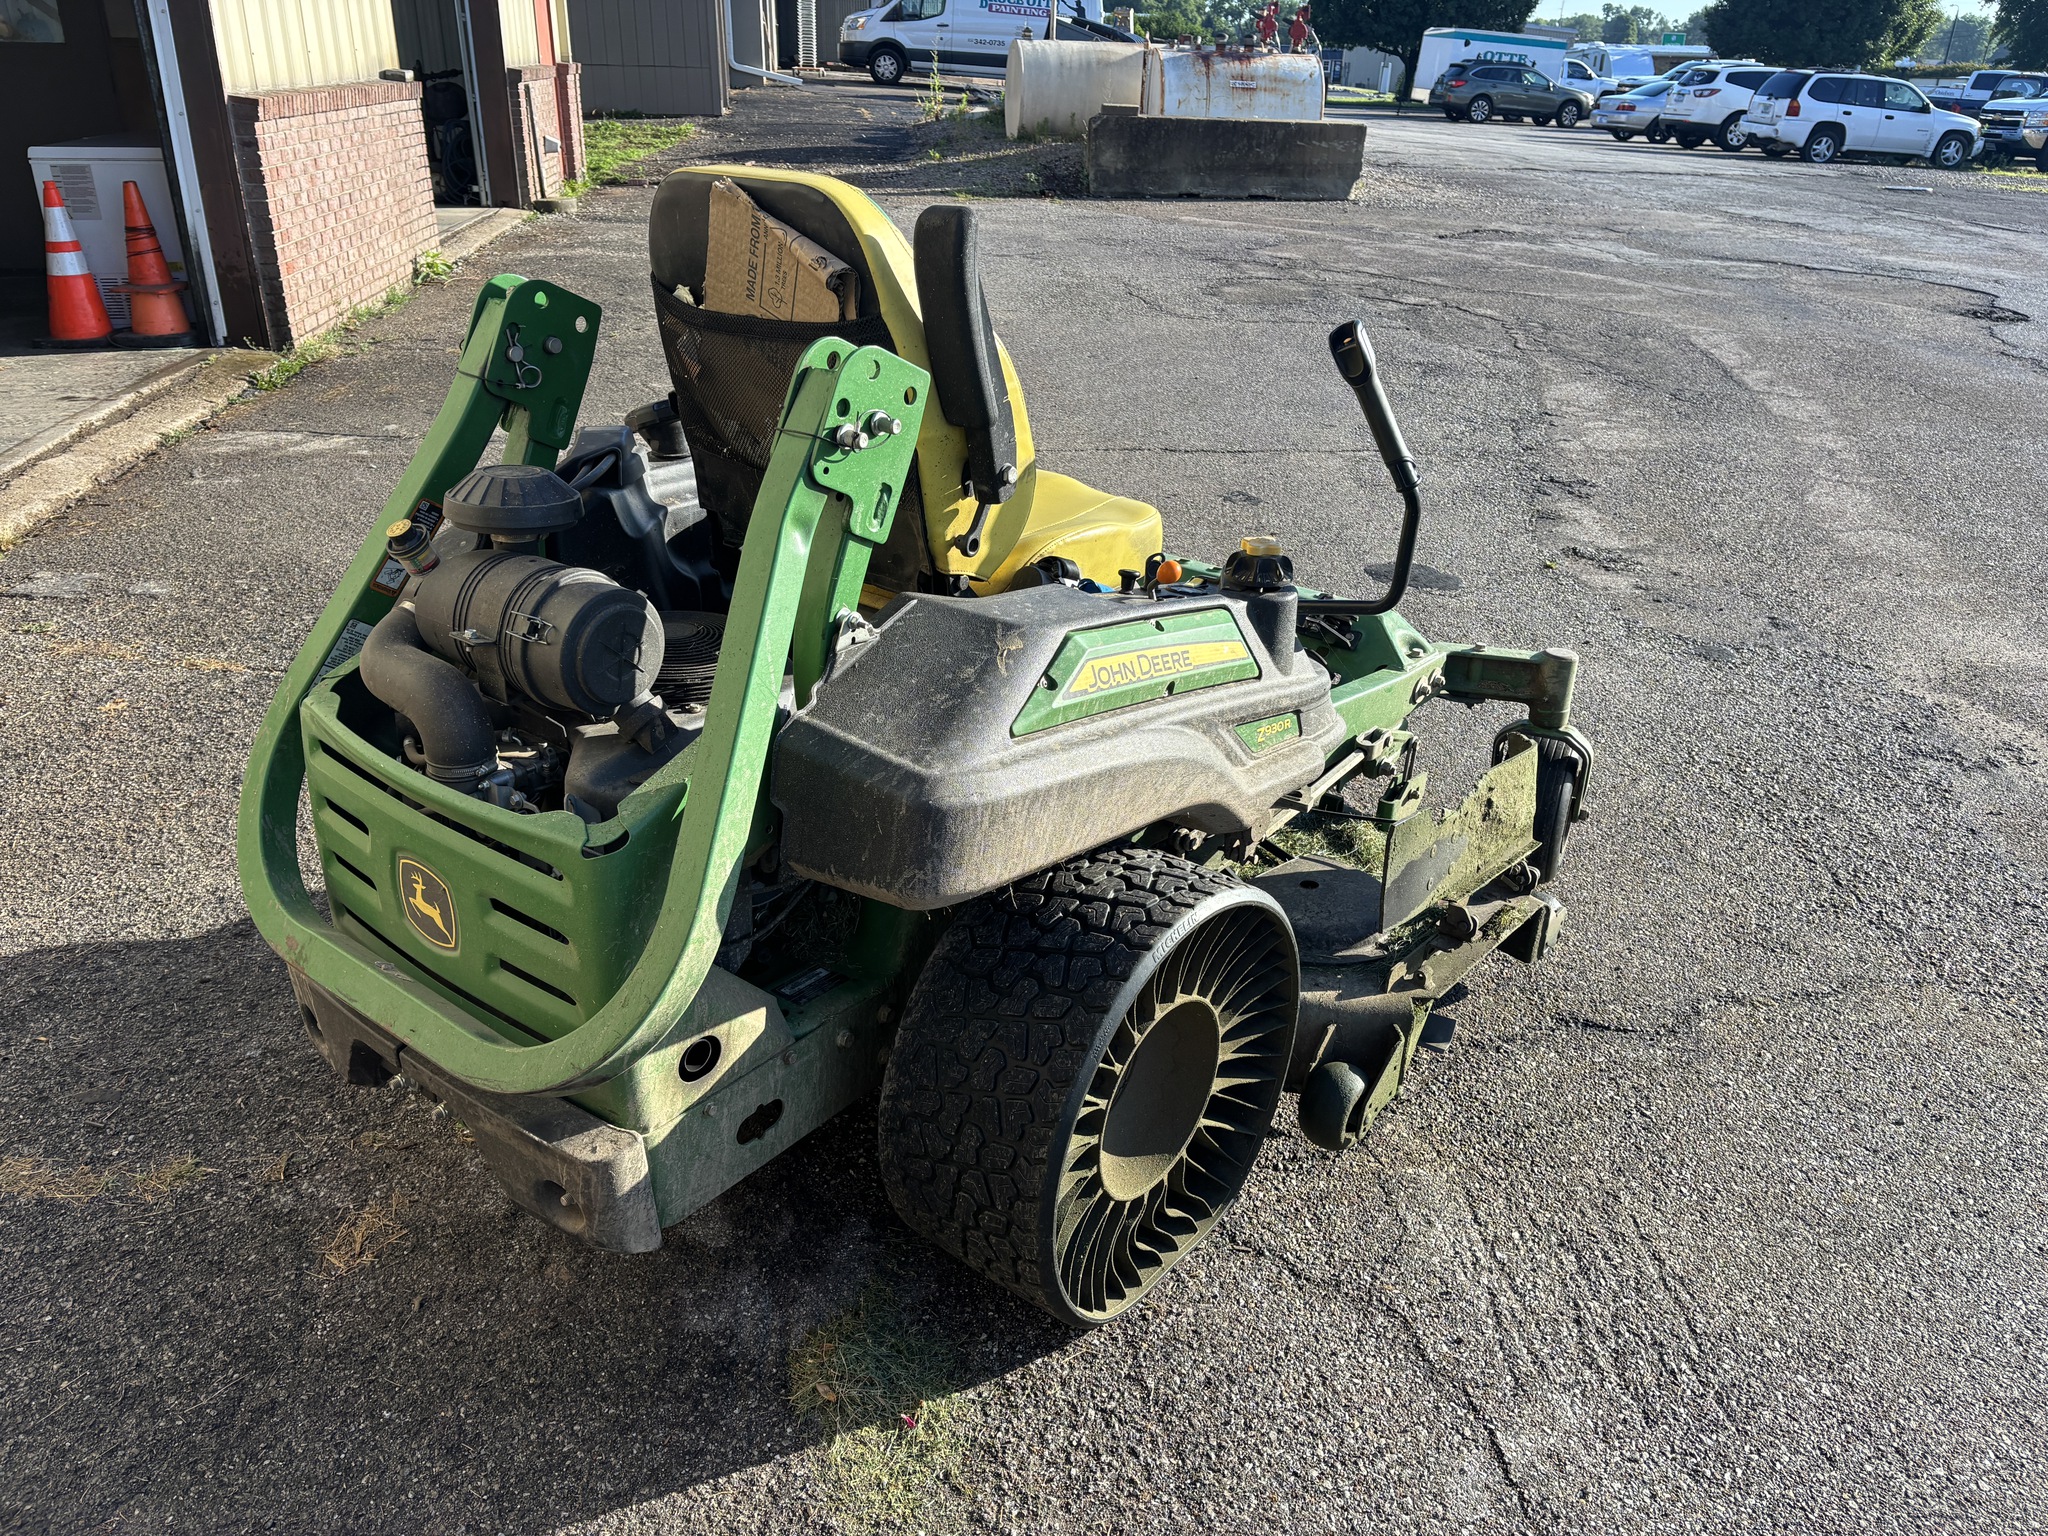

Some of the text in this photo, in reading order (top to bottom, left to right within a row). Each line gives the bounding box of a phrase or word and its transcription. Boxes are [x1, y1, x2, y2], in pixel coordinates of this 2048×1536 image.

[991, 4, 1048, 16] PAINTING
[973, 38, 1006, 47] 342-0735
[1483, 50, 1528, 63] OTTE
[750, 213, 761, 258] FROM
[775, 241, 785, 273] MILLION
[745, 258, 758, 302] MADE
[1088, 650, 1193, 689] JOHN DEERE
[1256, 718, 1292, 743] Z930R
[1151, 910, 1200, 964] MICHELIN
